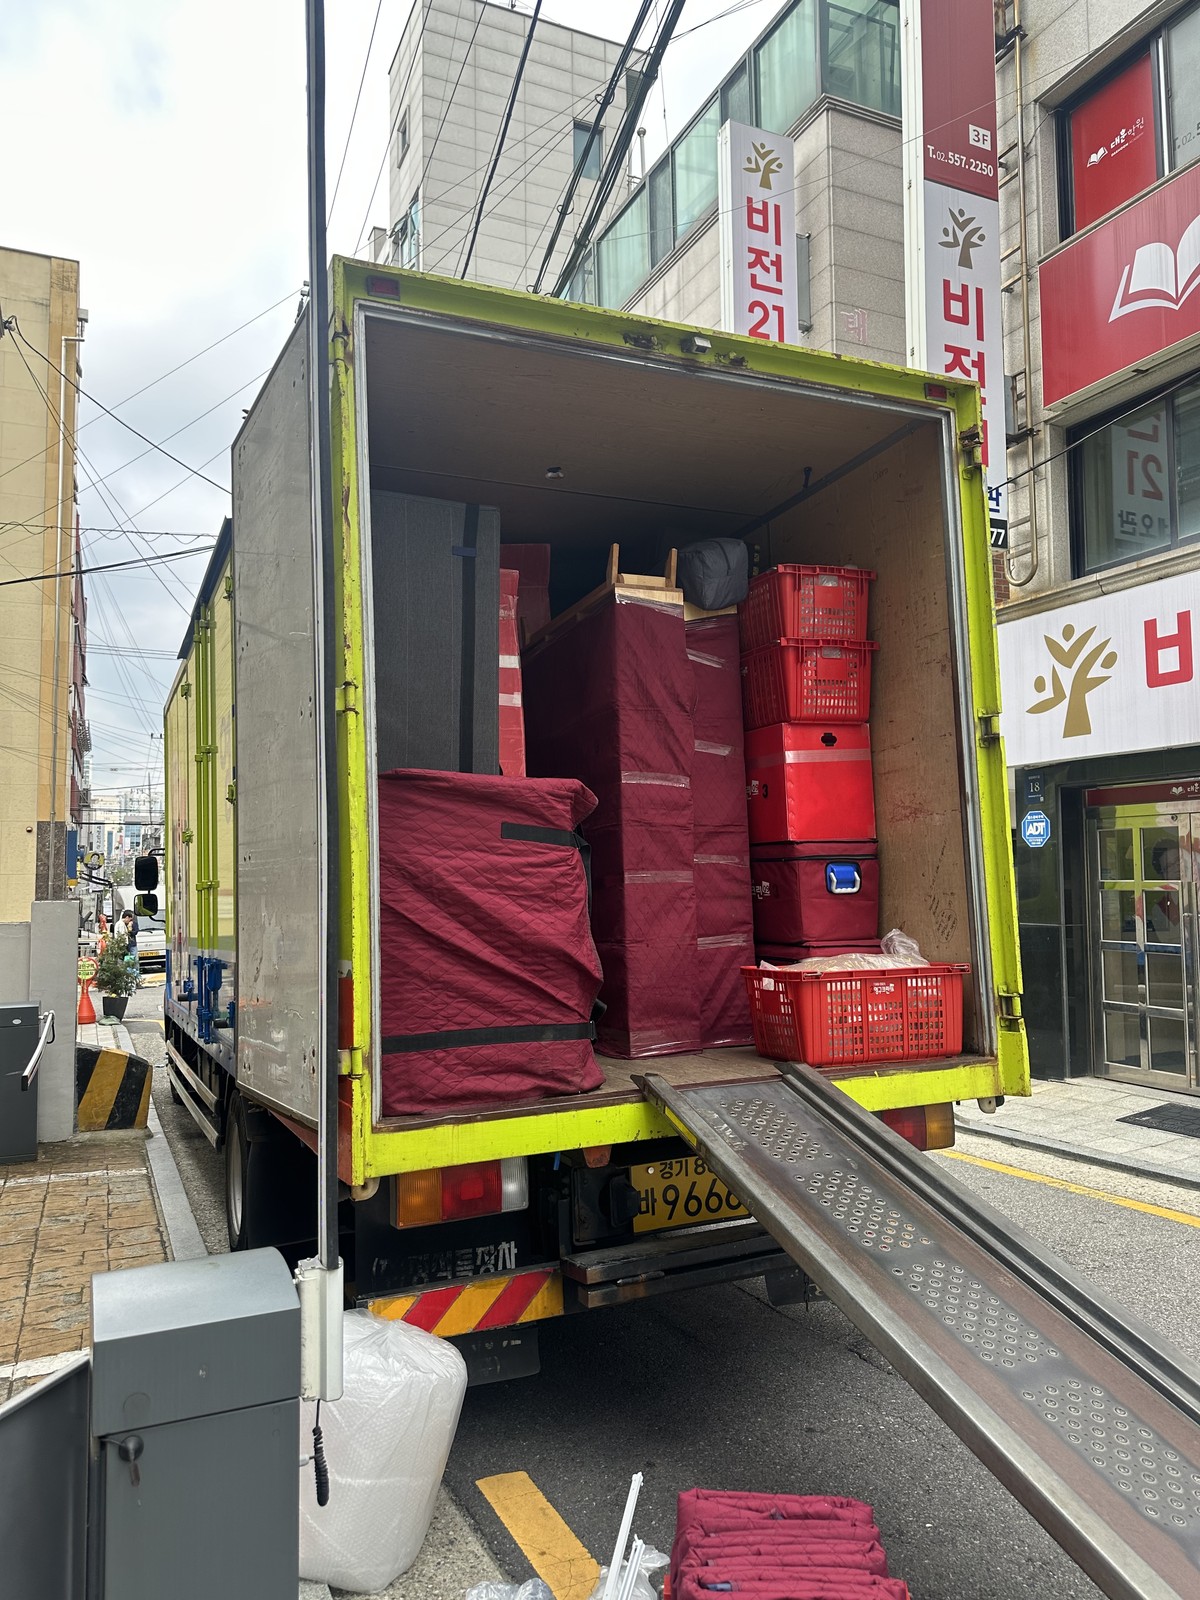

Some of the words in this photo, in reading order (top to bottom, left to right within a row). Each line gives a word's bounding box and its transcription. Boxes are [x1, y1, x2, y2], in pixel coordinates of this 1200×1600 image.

[973, 129, 988, 145] 3F
[927, 145, 994, 177] T.02.557.2250
[1030, 782, 1040, 792] 18
[1026, 822, 1046, 836] ADT
[659, 1159, 689, 1179] 경기
[693, 1157, 714, 1176] 8
